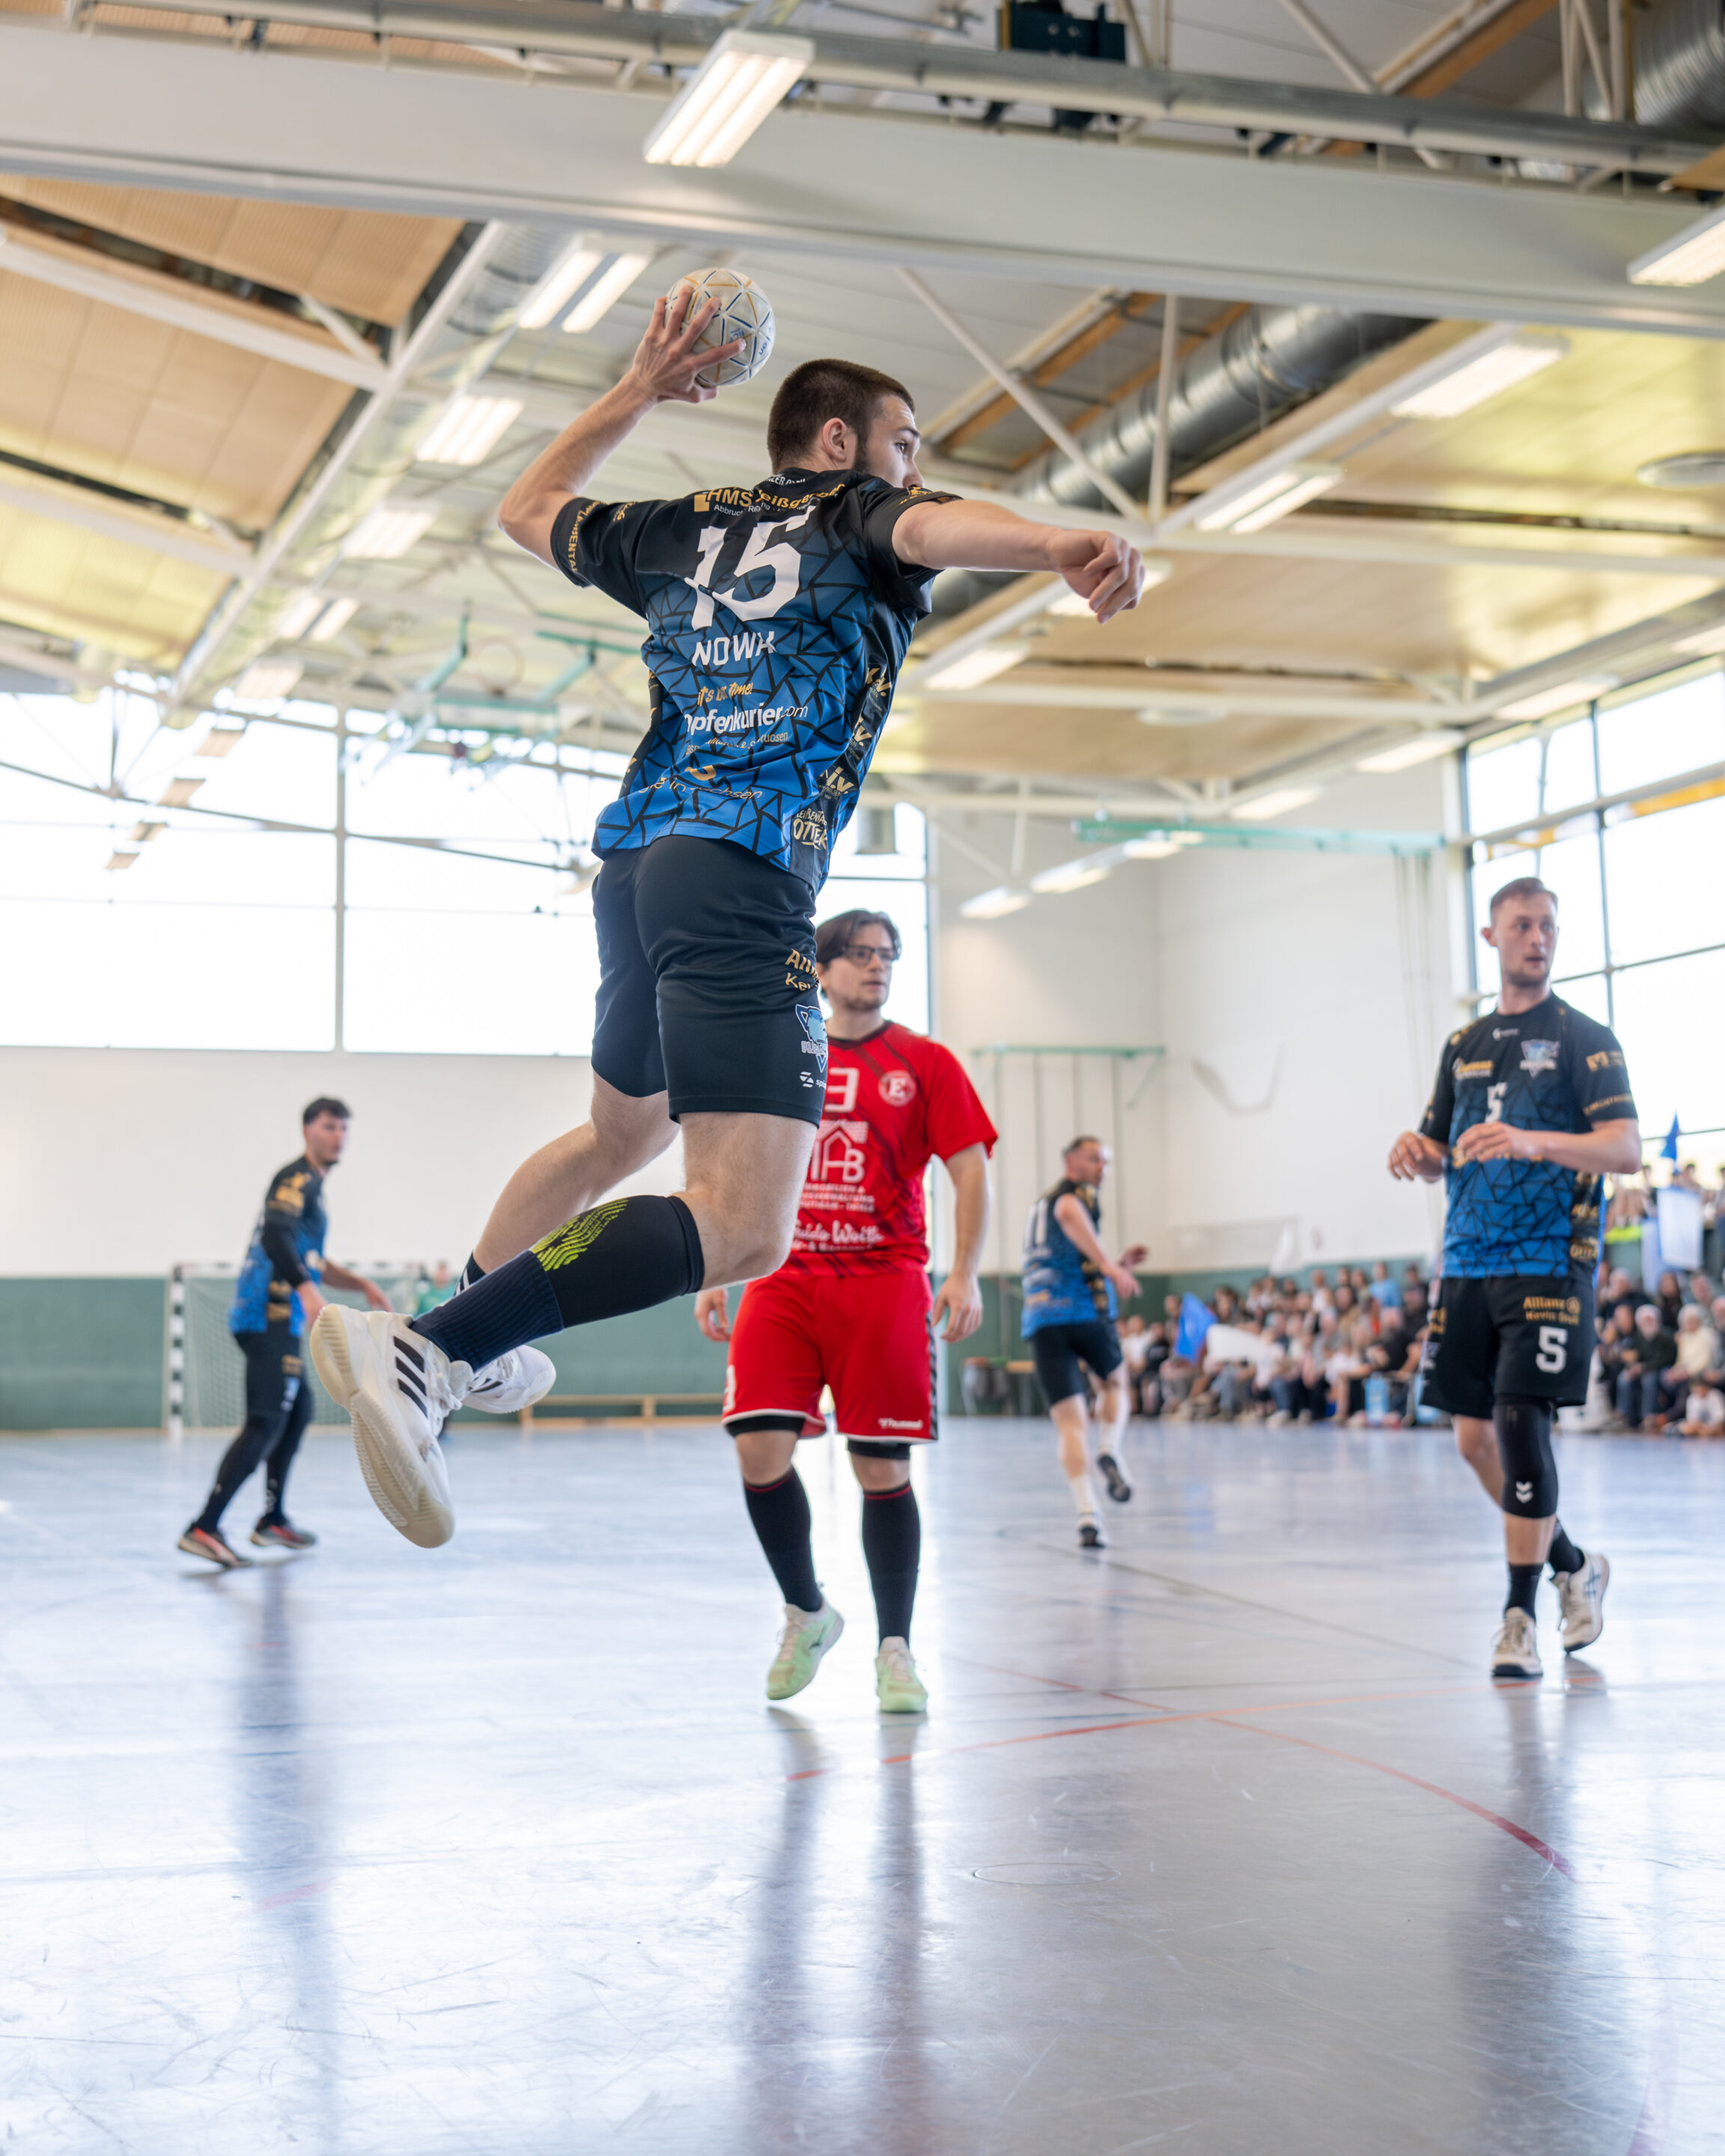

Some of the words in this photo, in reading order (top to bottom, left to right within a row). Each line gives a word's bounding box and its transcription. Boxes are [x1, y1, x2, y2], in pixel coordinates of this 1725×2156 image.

[684, 505, 816, 631] 15
[1485, 1082, 1508, 1124] 5
[1536, 1324, 1569, 1374] 5
